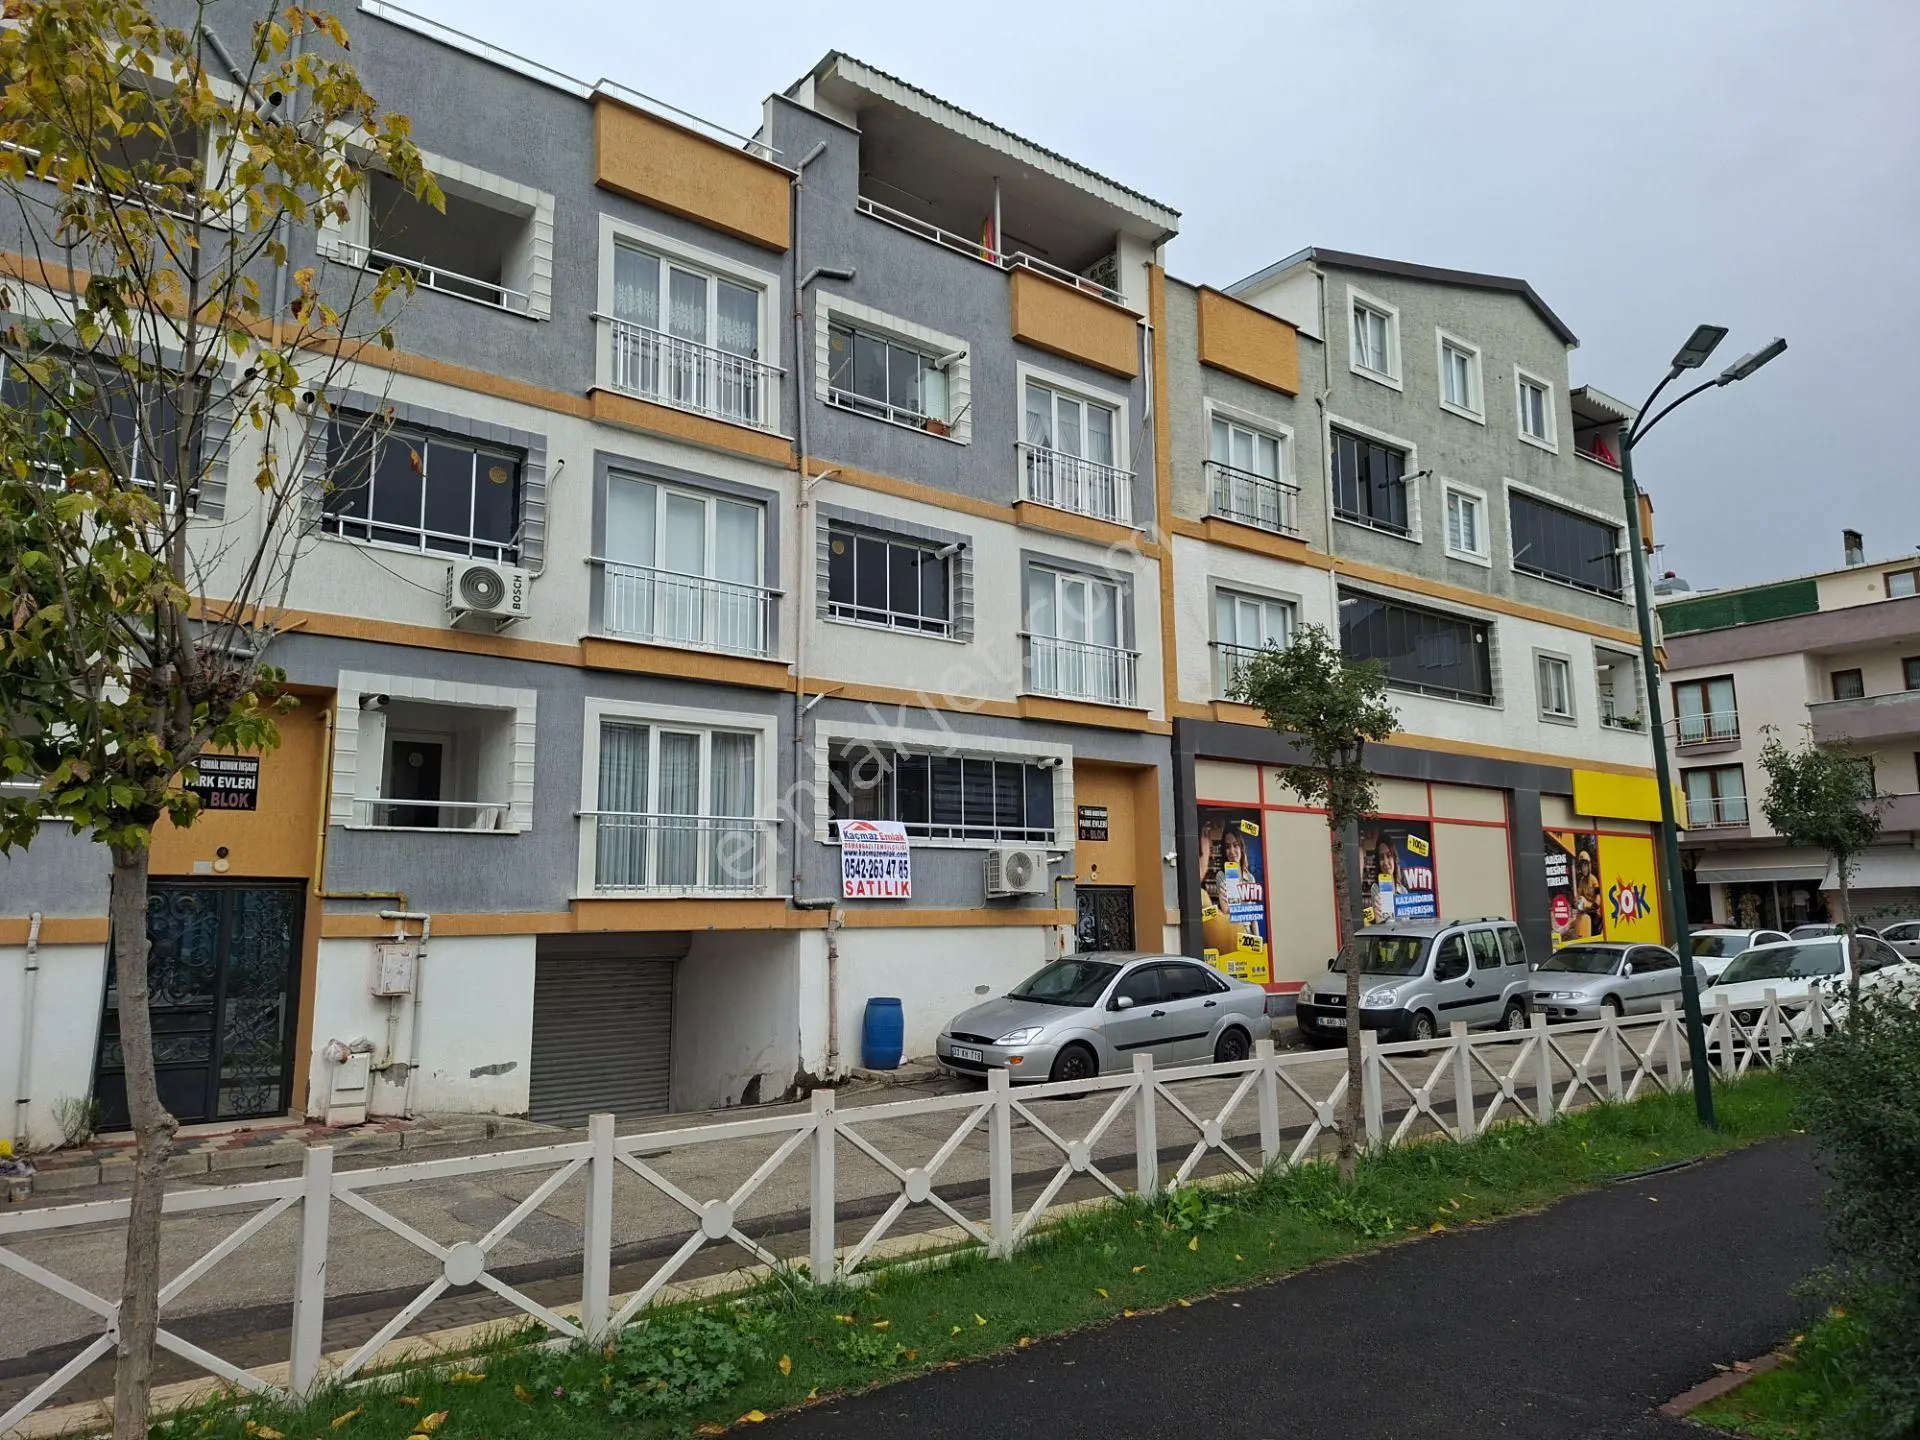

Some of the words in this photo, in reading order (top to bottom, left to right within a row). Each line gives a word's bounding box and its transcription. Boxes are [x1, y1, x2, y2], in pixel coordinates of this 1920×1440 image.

[512, 575, 522, 610] BOSCH
[217, 776, 256, 789] EVLERİ
[211, 792, 249, 807] BLOK
[843, 831, 878, 842] Kaçmaz
[879, 832, 904, 841] Emlak
[845, 858, 884, 879] 0542-263
[886, 859, 896, 878] 47
[1404, 867, 1432, 890] Win
[845, 880, 910, 896] SATILIK
[1238, 884, 1262, 902] Win
